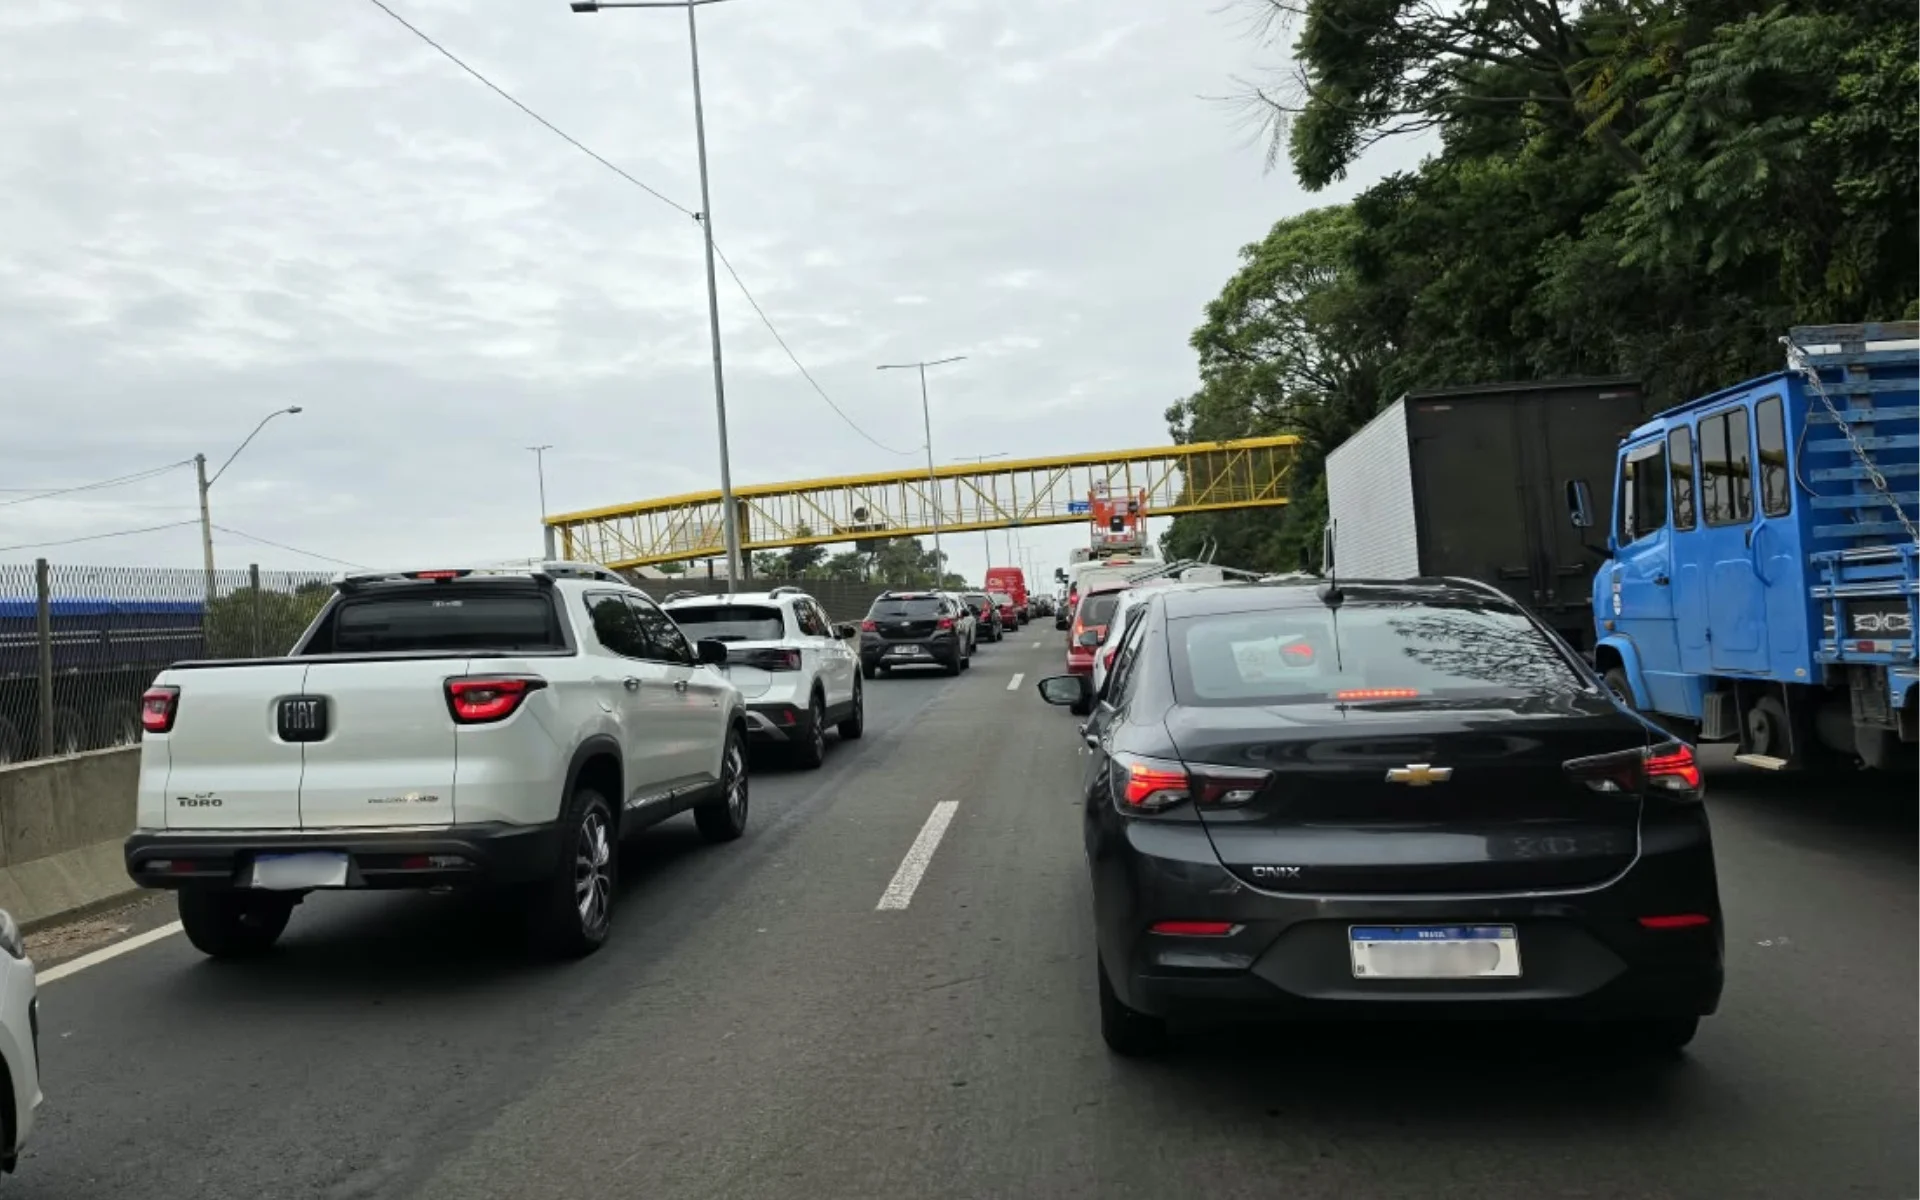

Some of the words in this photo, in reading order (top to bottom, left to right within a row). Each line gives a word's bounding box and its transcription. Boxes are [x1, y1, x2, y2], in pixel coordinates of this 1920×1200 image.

[284, 701, 317, 729] FIAT
[176, 796, 223, 807] TORO
[1252, 866, 1301, 878] ONIX
